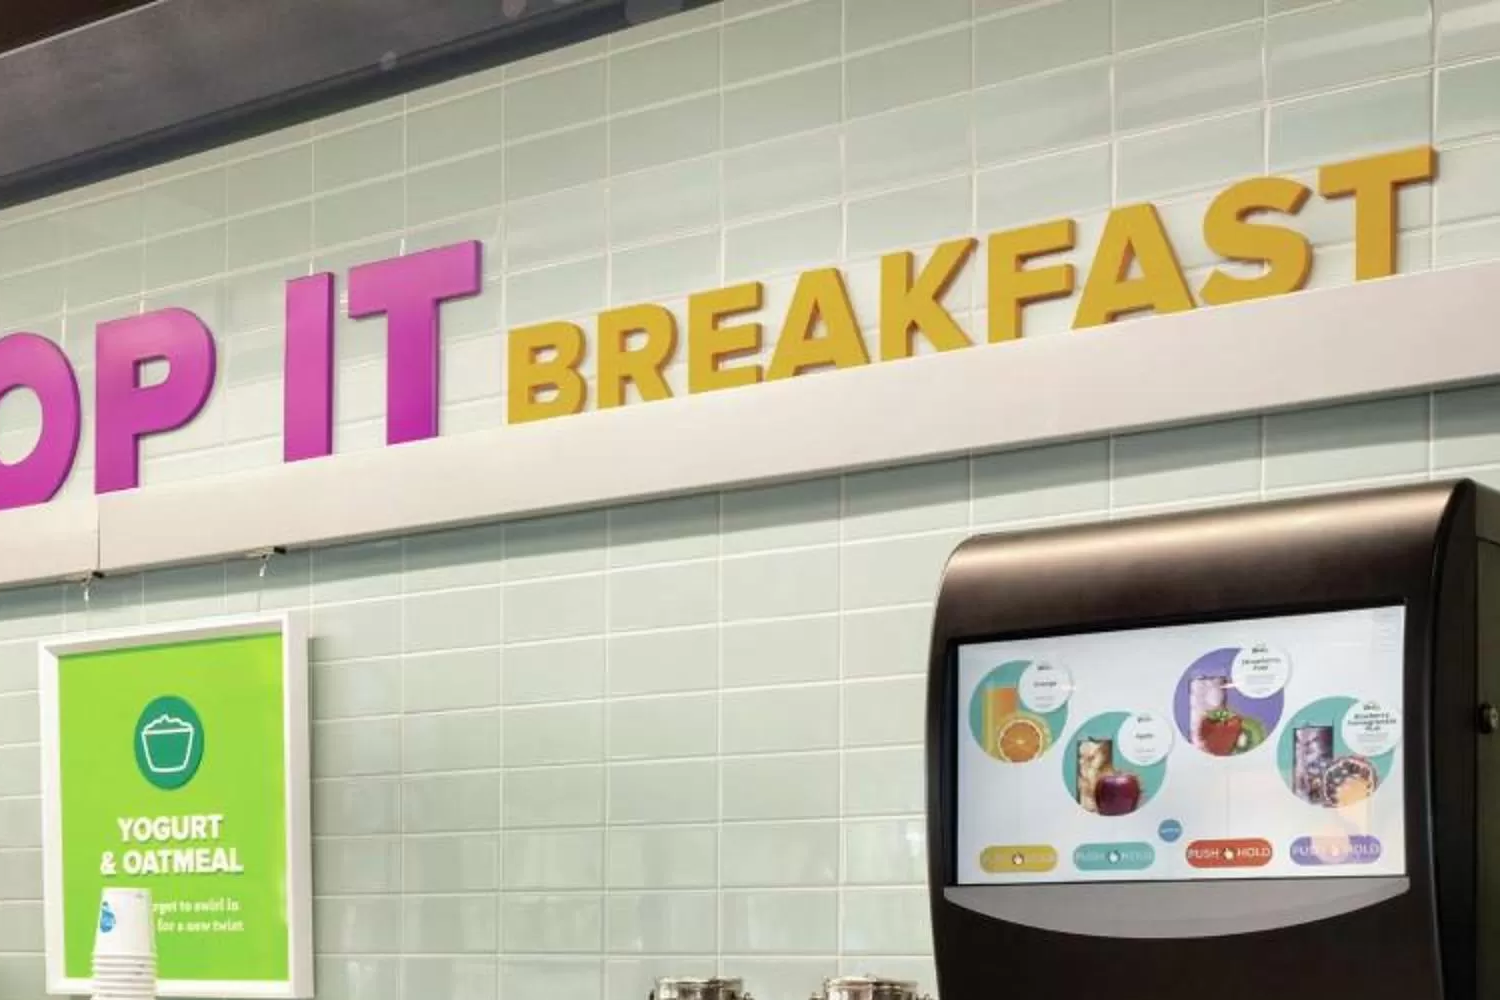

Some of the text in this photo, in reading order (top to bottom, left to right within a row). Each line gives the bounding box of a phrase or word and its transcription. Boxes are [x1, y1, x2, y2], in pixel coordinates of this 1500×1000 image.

[284, 239, 482, 463] IT
[507, 144, 1440, 425] BREAKFAST
[117, 815, 223, 842] YOGURT
[100, 848, 244, 875] & OATMEAL
[1187, 846, 1271, 860] PUSH HOLD
